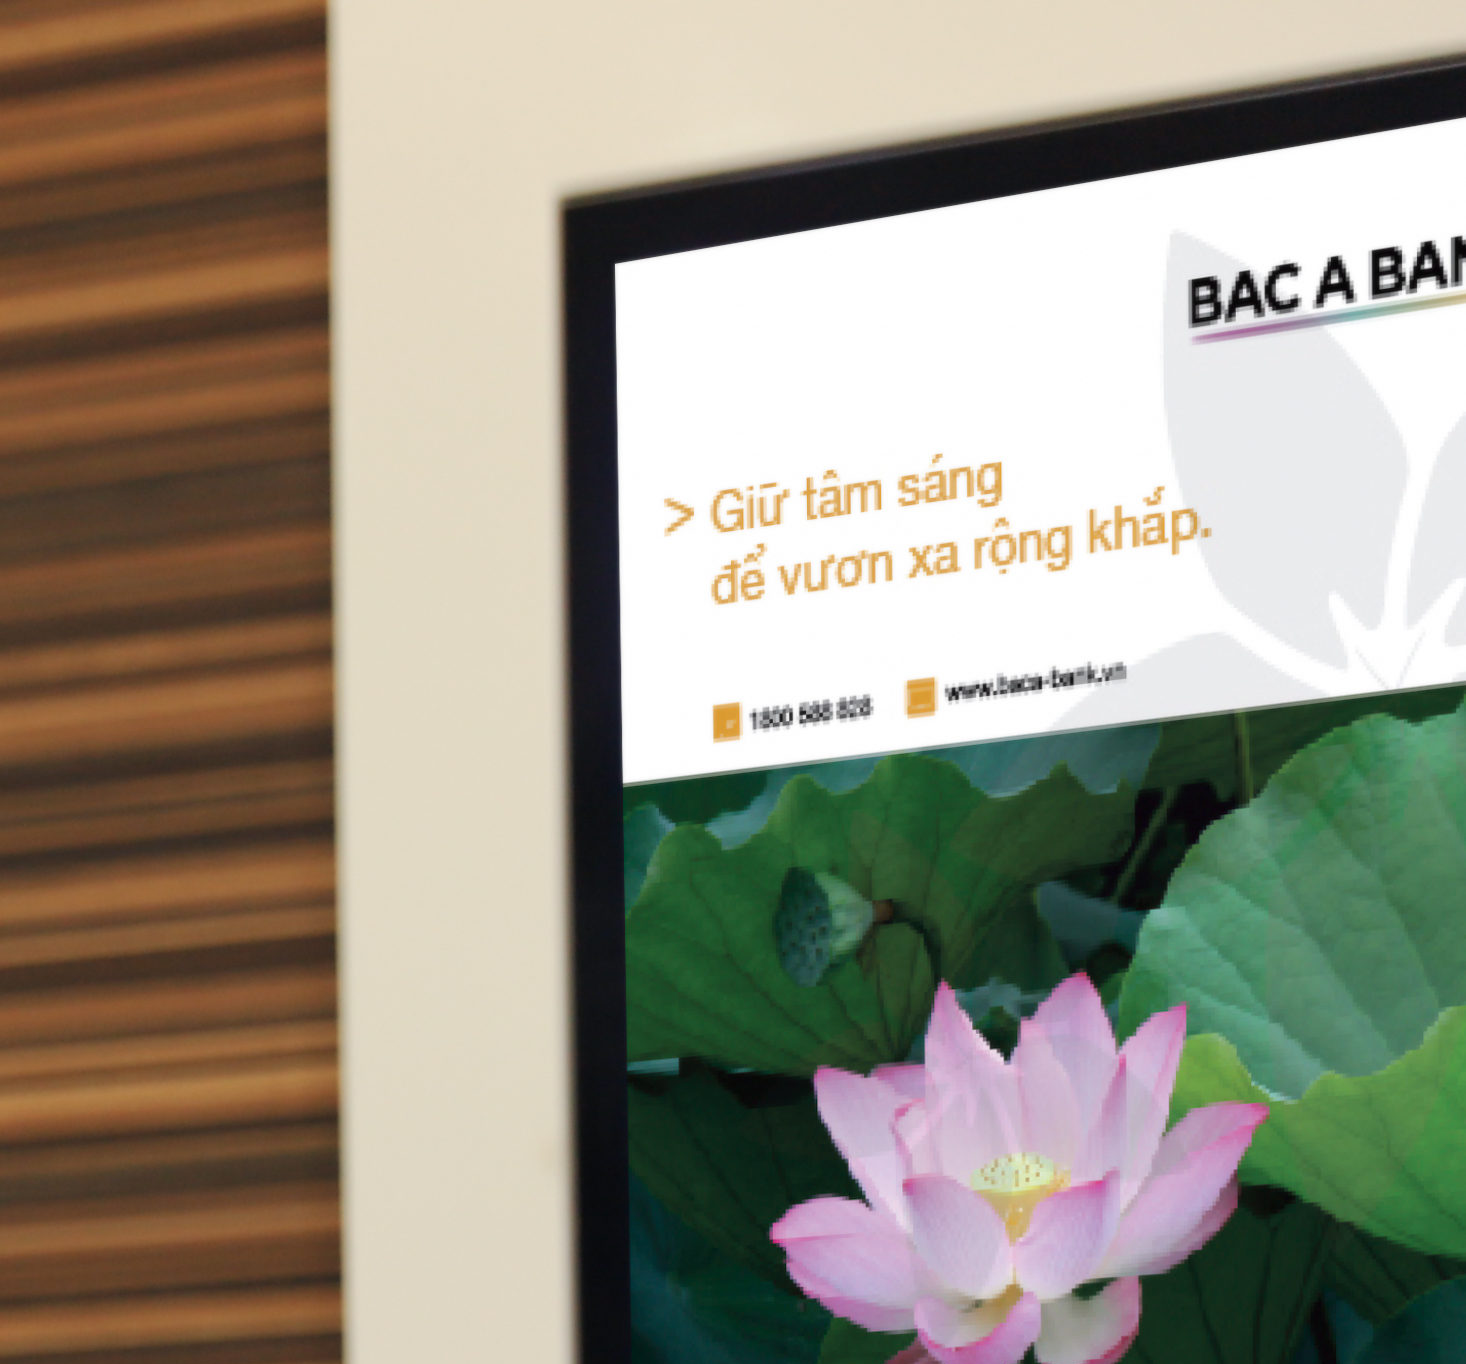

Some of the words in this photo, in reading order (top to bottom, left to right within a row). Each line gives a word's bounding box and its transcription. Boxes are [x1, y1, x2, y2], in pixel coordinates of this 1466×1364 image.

[1188, 259, 1302, 329] BAC
[1313, 254, 1358, 309] A
[710, 481, 790, 533] Giữ
[800, 469, 882, 520] tâm
[897, 453, 1002, 508] sáng
[711, 543, 768, 605] để
[777, 549, 893, 596] vươn
[907, 541, 962, 578] xa
[974, 516, 1073, 573] rộng
[1086, 486, 1213, 556] khắp.
[749, 704, 794, 732] 1800
